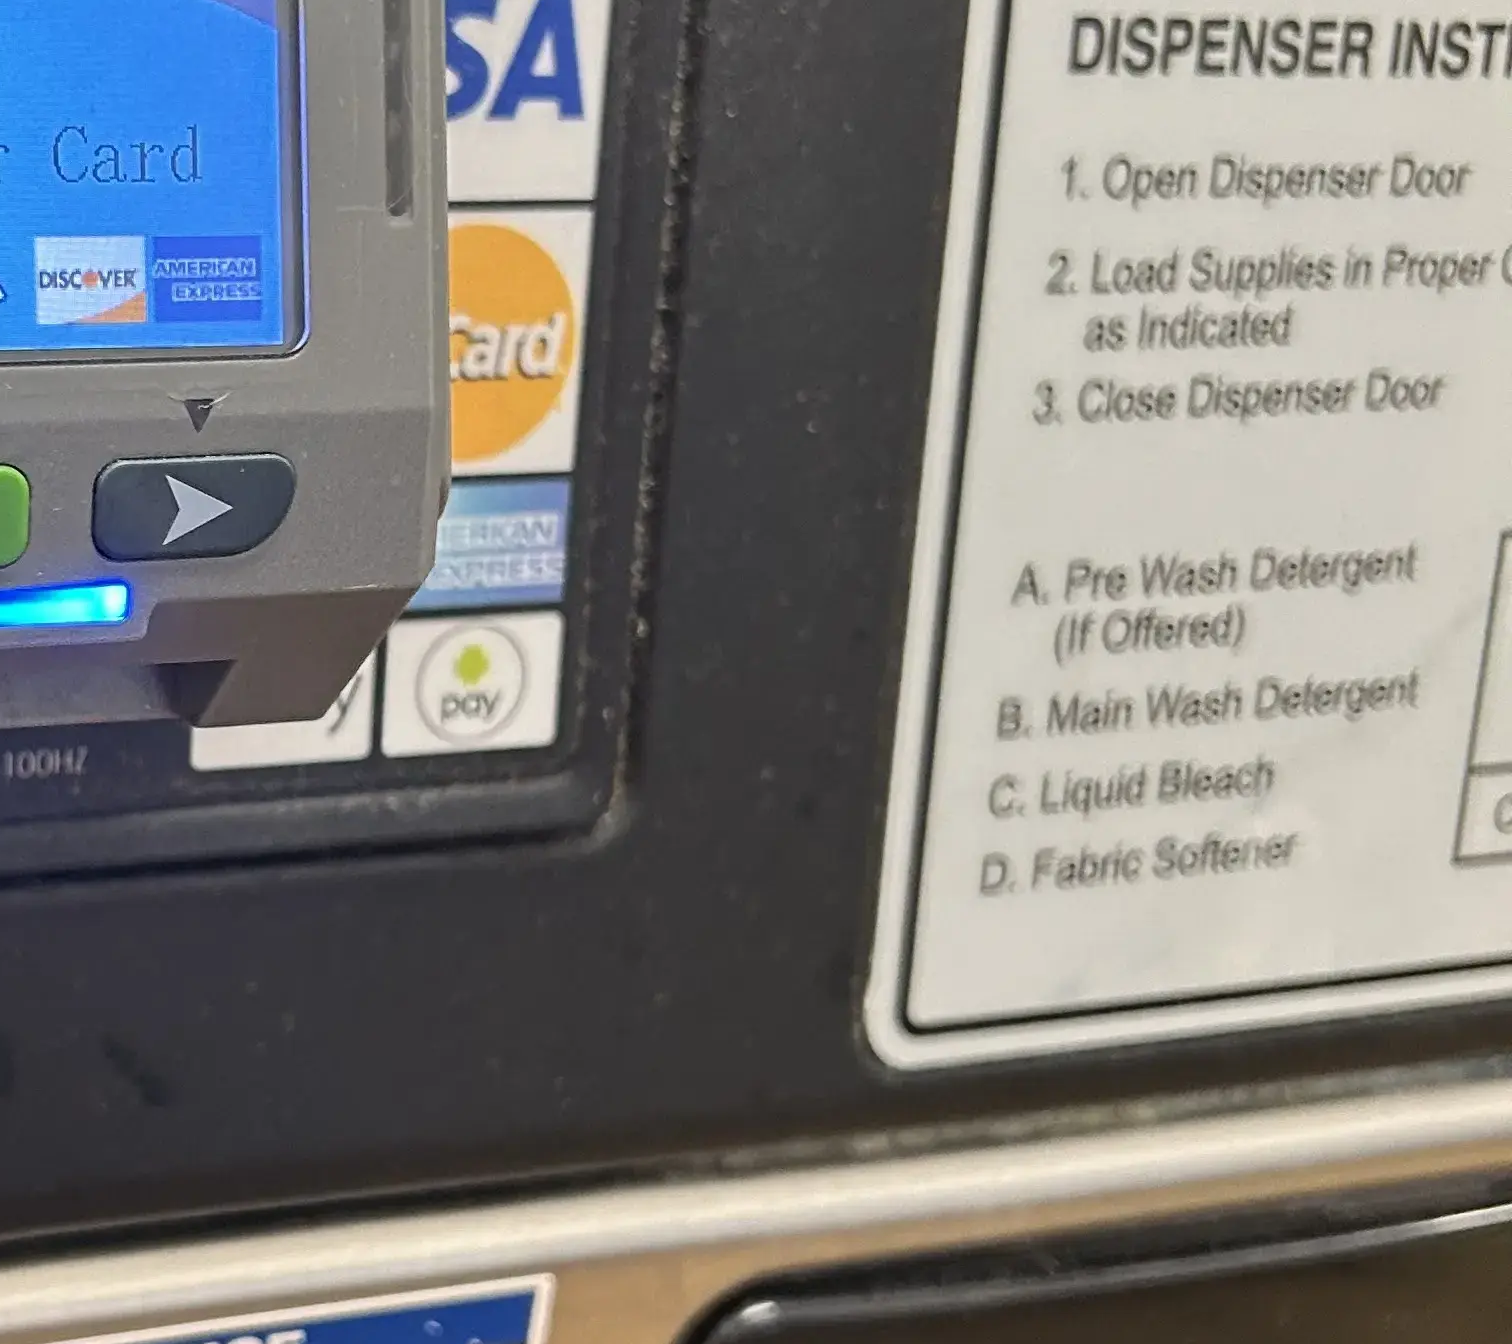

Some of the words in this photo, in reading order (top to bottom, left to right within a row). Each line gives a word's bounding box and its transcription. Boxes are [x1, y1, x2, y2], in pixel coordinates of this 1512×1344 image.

[1068, 16, 1374, 79] DISPENSER
[53, 122, 204, 185] Card
[1061, 155, 1088, 200] 1.
[1102, 155, 1197, 209] Open
[1208, 153, 1384, 209] Dispenser
[1389, 152, 1472, 198] Door
[155, 260, 254, 278] AMERICAN
[175, 284, 262, 300] EXPRESS
[1044, 248, 1078, 295] 2.
[1091, 246, 1178, 294] Load
[1188, 245, 1333, 301] Supplies
[1343, 245, 1372, 286] in
[1383, 242, 1492, 294] Proper
[1083, 314, 1126, 352] as
[1136, 301, 1295, 350] Indicated
[1032, 377, 1062, 426] 3.
[1078, 375, 1176, 424] Close
[1187, 372, 1359, 425] Dispenser
[1365, 367, 1449, 413] Door
[1011, 561, 1049, 606] A.
[1063, 558, 1128, 603] Pre
[1140, 551, 1237, 597] Wash
[1249, 541, 1419, 596] Detergent
[1101, 602, 1246, 655] Offered)
[441, 689, 500, 722] pay
[1046, 690, 1135, 736] Main
[1146, 683, 1243, 728] Wash
[1254, 667, 1420, 724] Detergent
[1040, 766, 1147, 821] Liquid
[1157, 755, 1274, 804] Bleach
[1030, 845, 1143, 893] Fabric
[1152, 830, 1299, 880] Softener
